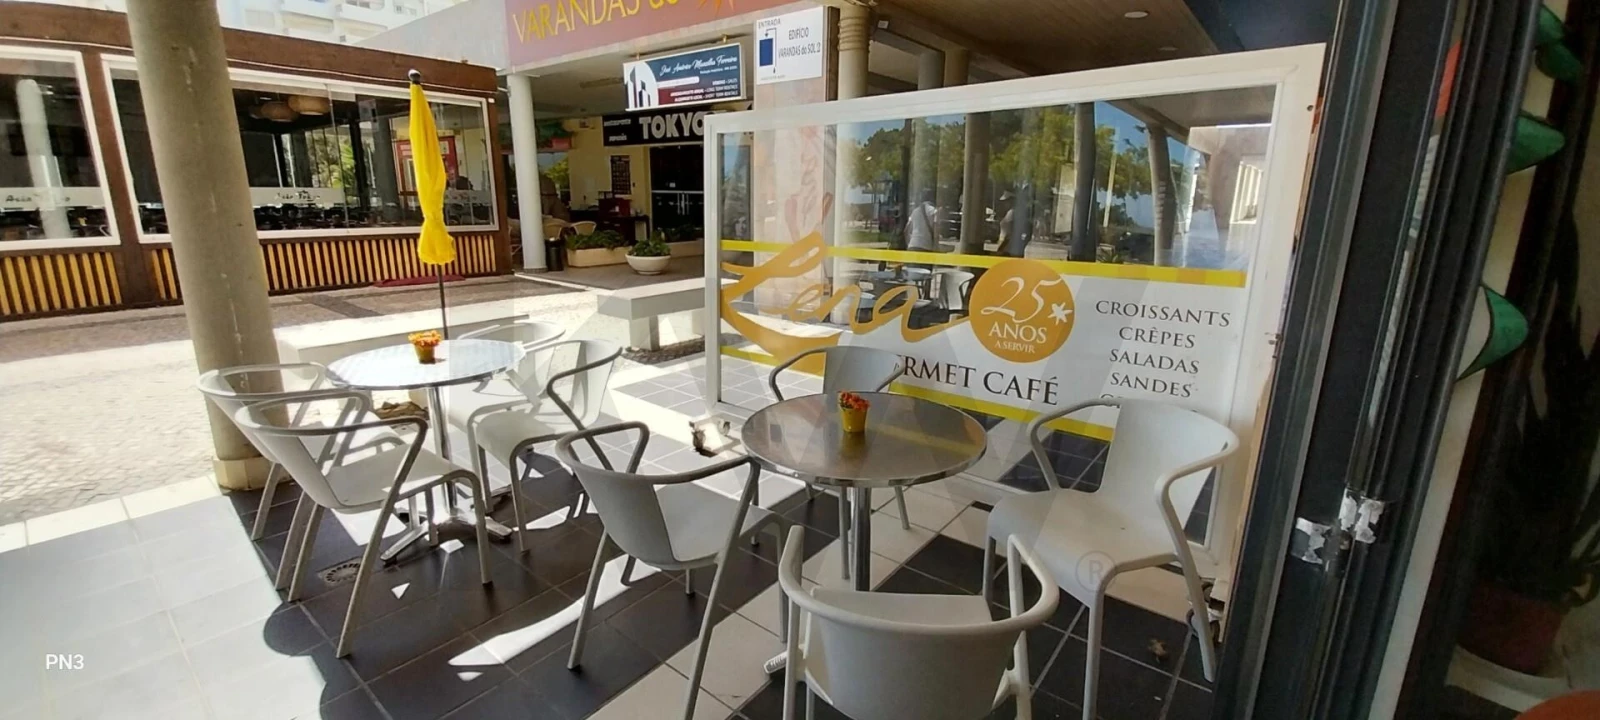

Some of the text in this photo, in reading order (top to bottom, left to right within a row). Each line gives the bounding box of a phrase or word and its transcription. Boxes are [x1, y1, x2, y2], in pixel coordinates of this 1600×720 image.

[758, 19, 781, 28] ENTRADA
[779, 45, 801, 58] VARANDAS
[801, 46, 807, 55] do
[807, 43, 816, 55] SOL
[980, 276, 1062, 324] 25
[1095, 299, 1231, 328] CROISSANTS
[988, 321, 1047, 344] ANOS
[1119, 325, 1196, 349] CRÊPES
[995, 340, 1035, 354] A SERVIR
[1109, 348, 1200, 374] SALADAS
[982, 370, 1059, 406] CAFÉ
[1110, 372, 1192, 398] SANDES
